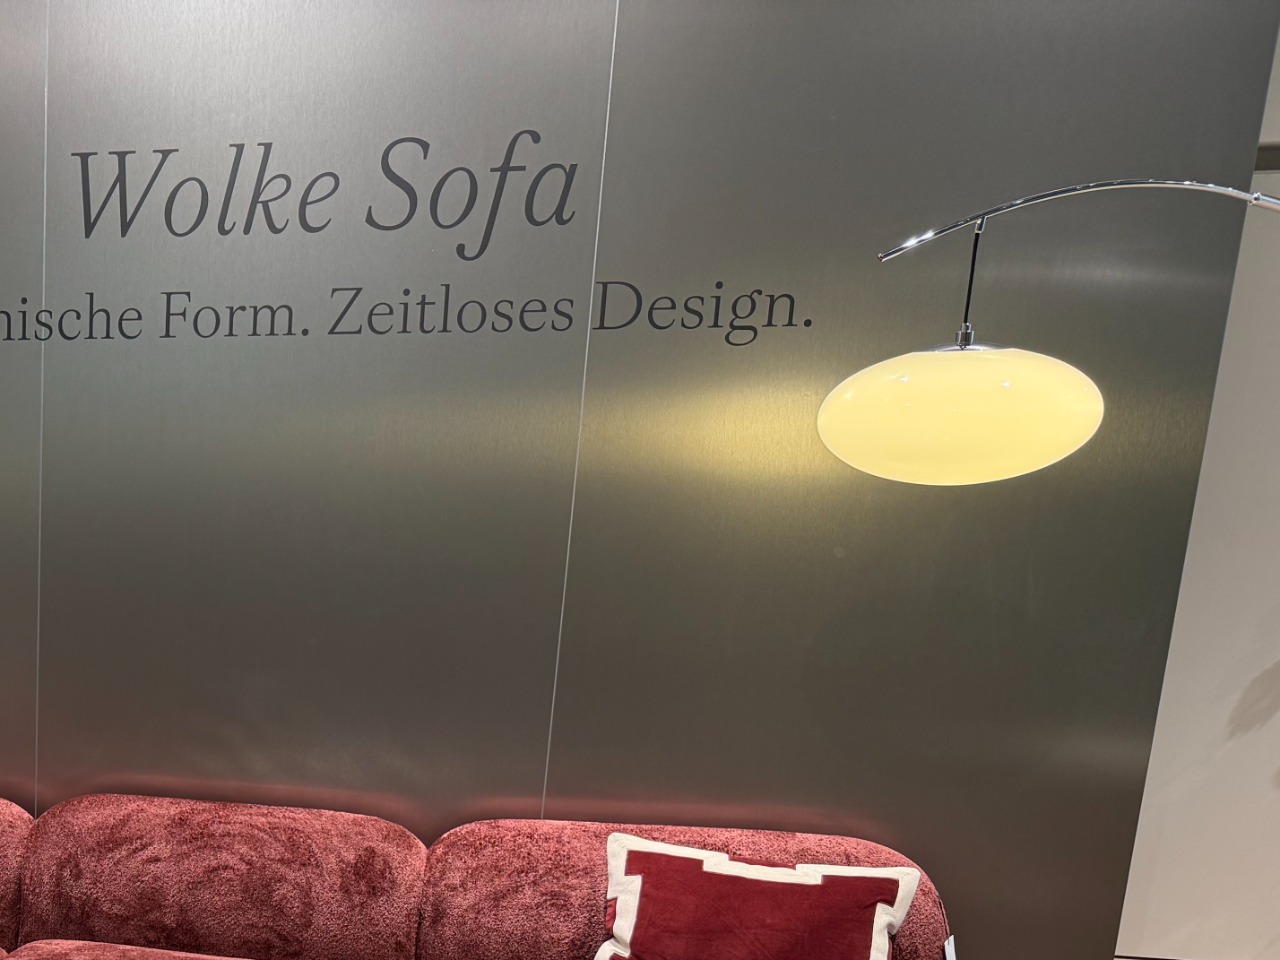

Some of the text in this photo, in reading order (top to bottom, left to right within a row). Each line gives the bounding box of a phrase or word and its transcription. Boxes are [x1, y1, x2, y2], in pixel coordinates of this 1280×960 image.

[71, 130, 578, 261] Wolke Sofa
[159, 291, 309, 338] Form.
[328, 284, 573, 335] Zeitloses
[592, 281, 812, 346] Design.
